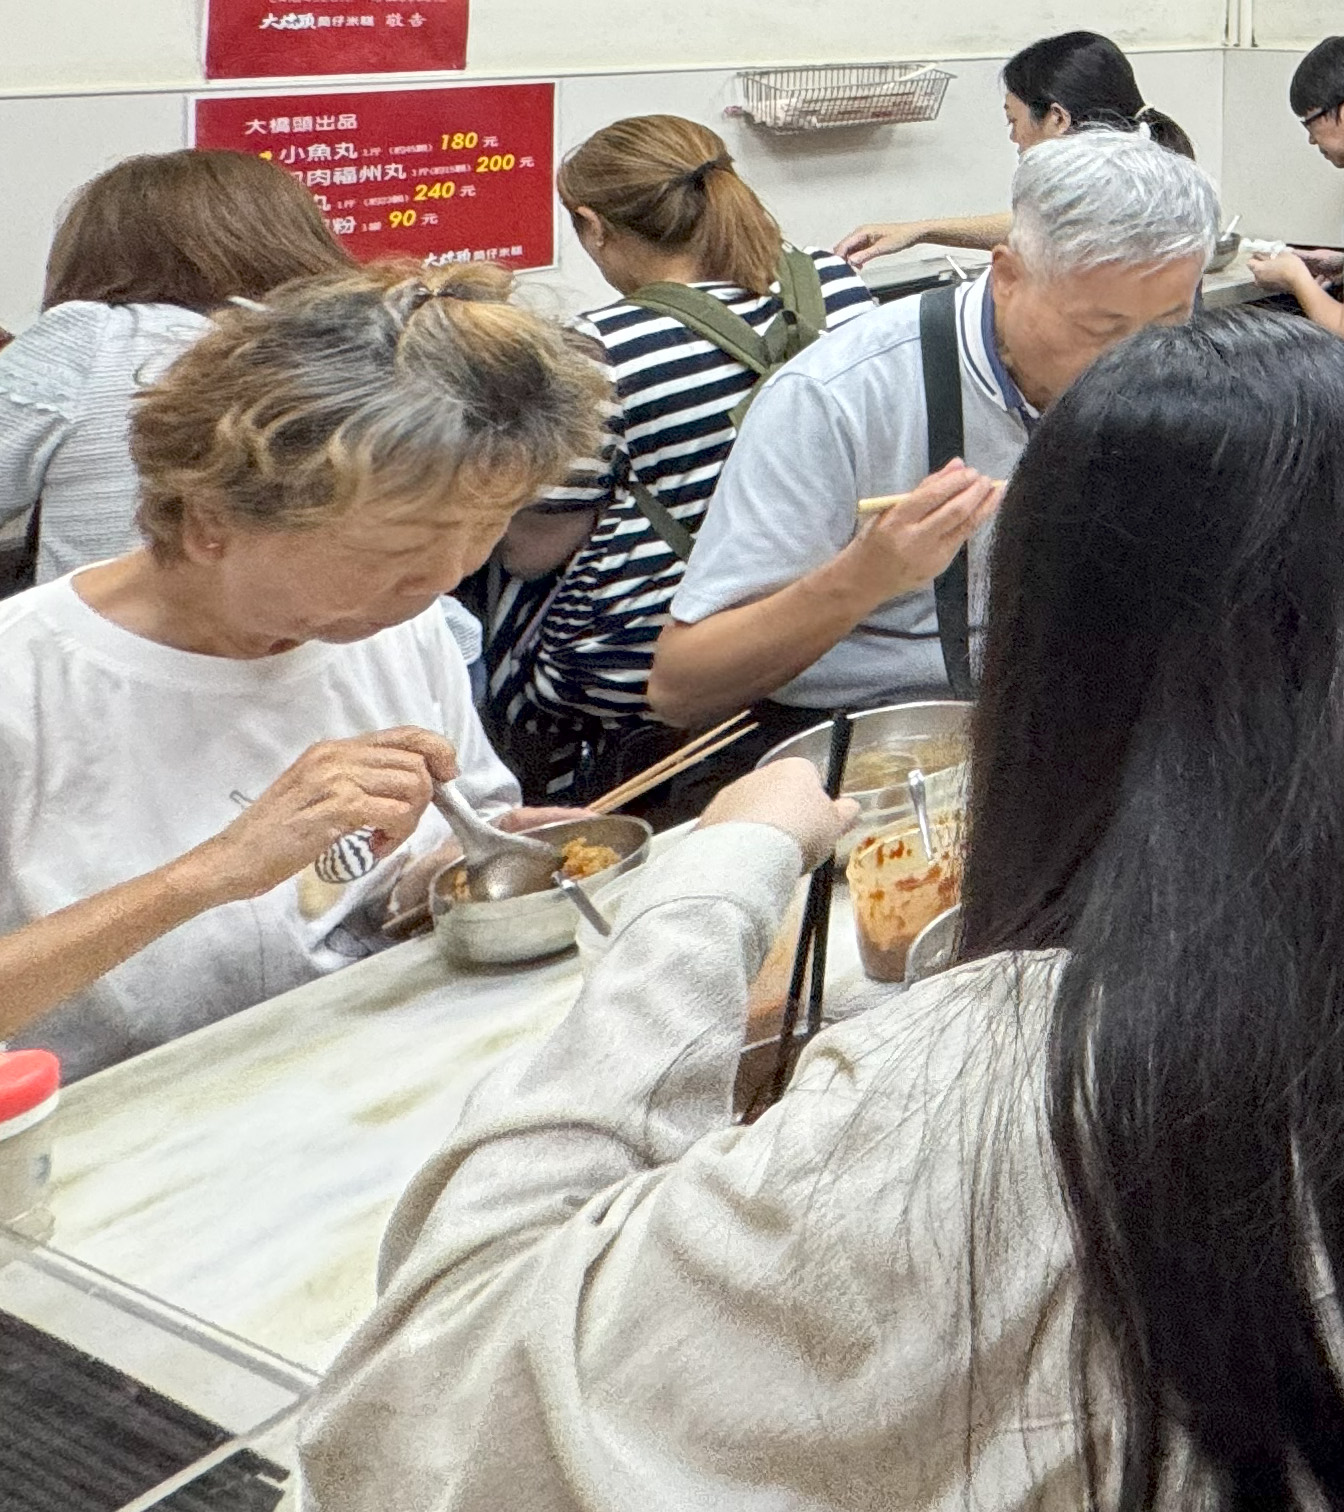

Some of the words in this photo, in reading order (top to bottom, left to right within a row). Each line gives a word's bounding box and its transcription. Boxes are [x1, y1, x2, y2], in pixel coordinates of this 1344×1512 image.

[245, 113, 358, 135] 大橋頭出品
[280, 142, 358, 164] 小魚丸
[441, 132, 479, 151] 180
[482, 136, 499, 149] 元
[475, 154, 515, 173] 200
[519, 156, 535, 169] 元
[413, 181, 455, 202] 240
[460, 185, 477, 197] 元
[388, 209, 417, 229] 90
[421, 213, 438, 226] 元
